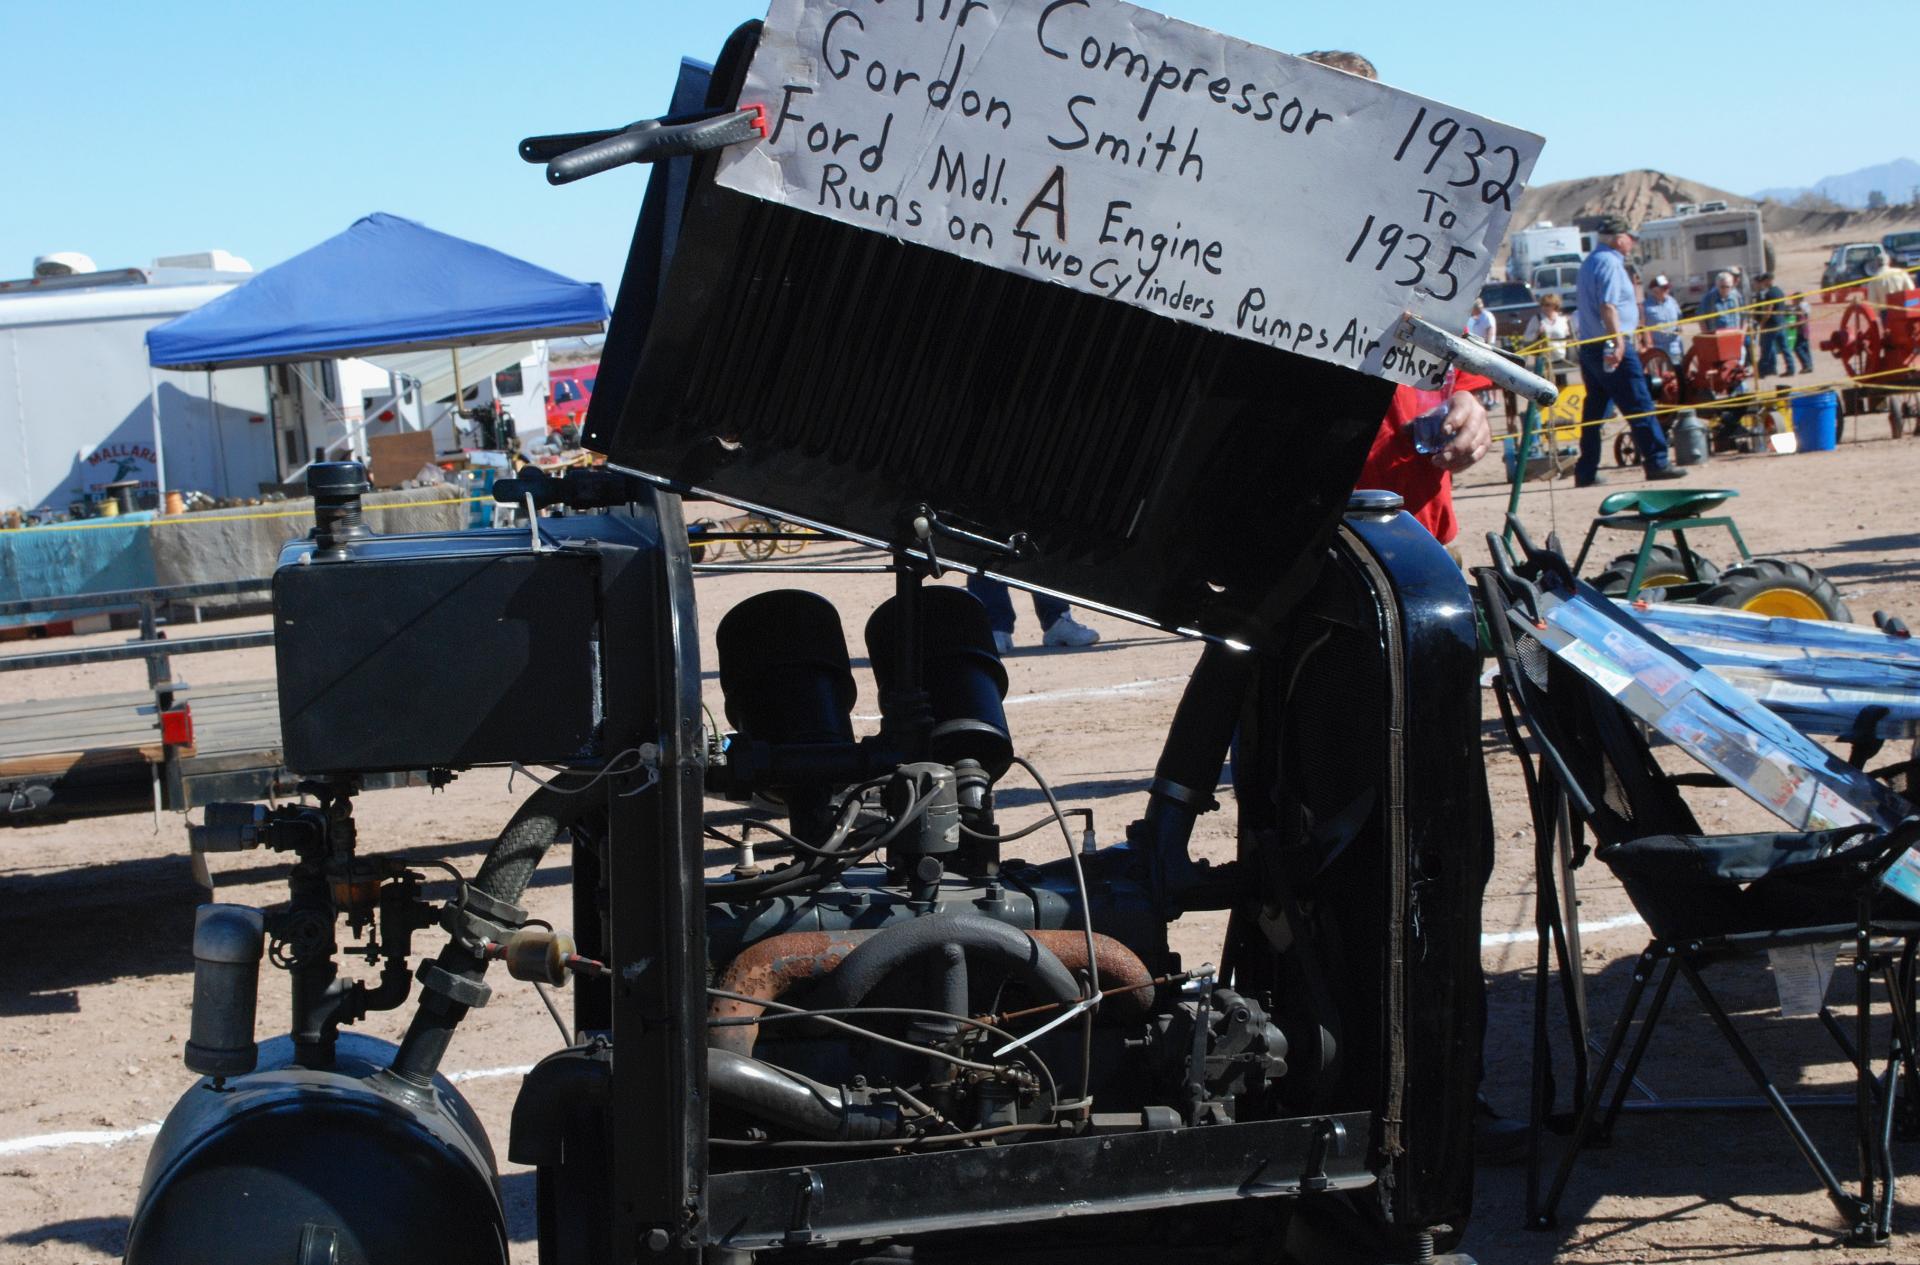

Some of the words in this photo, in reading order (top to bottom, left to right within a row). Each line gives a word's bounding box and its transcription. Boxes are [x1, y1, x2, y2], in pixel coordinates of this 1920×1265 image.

[822, 10, 1012, 130] Gordon
[1047, 94, 1204, 183] Smith
[1037, 0, 1334, 135] Compressor
[768, 84, 894, 174] Ford
[927, 144, 1009, 207] Mdl.
[1015, 164, 1067, 244] A
[1098, 200, 1223, 276] Engine
[1393, 107, 1521, 213] 1932
[1417, 188, 1459, 230] To
[818, 163, 923, 227] Runs
[948, 215, 994, 249] on
[1012, 228, 1083, 277] Two
[1088, 256, 1215, 320] Cylinders
[1236, 287, 1329, 350] Pumps
[1332, 317, 1381, 359] Air
[1345, 214, 1477, 302] 1935
